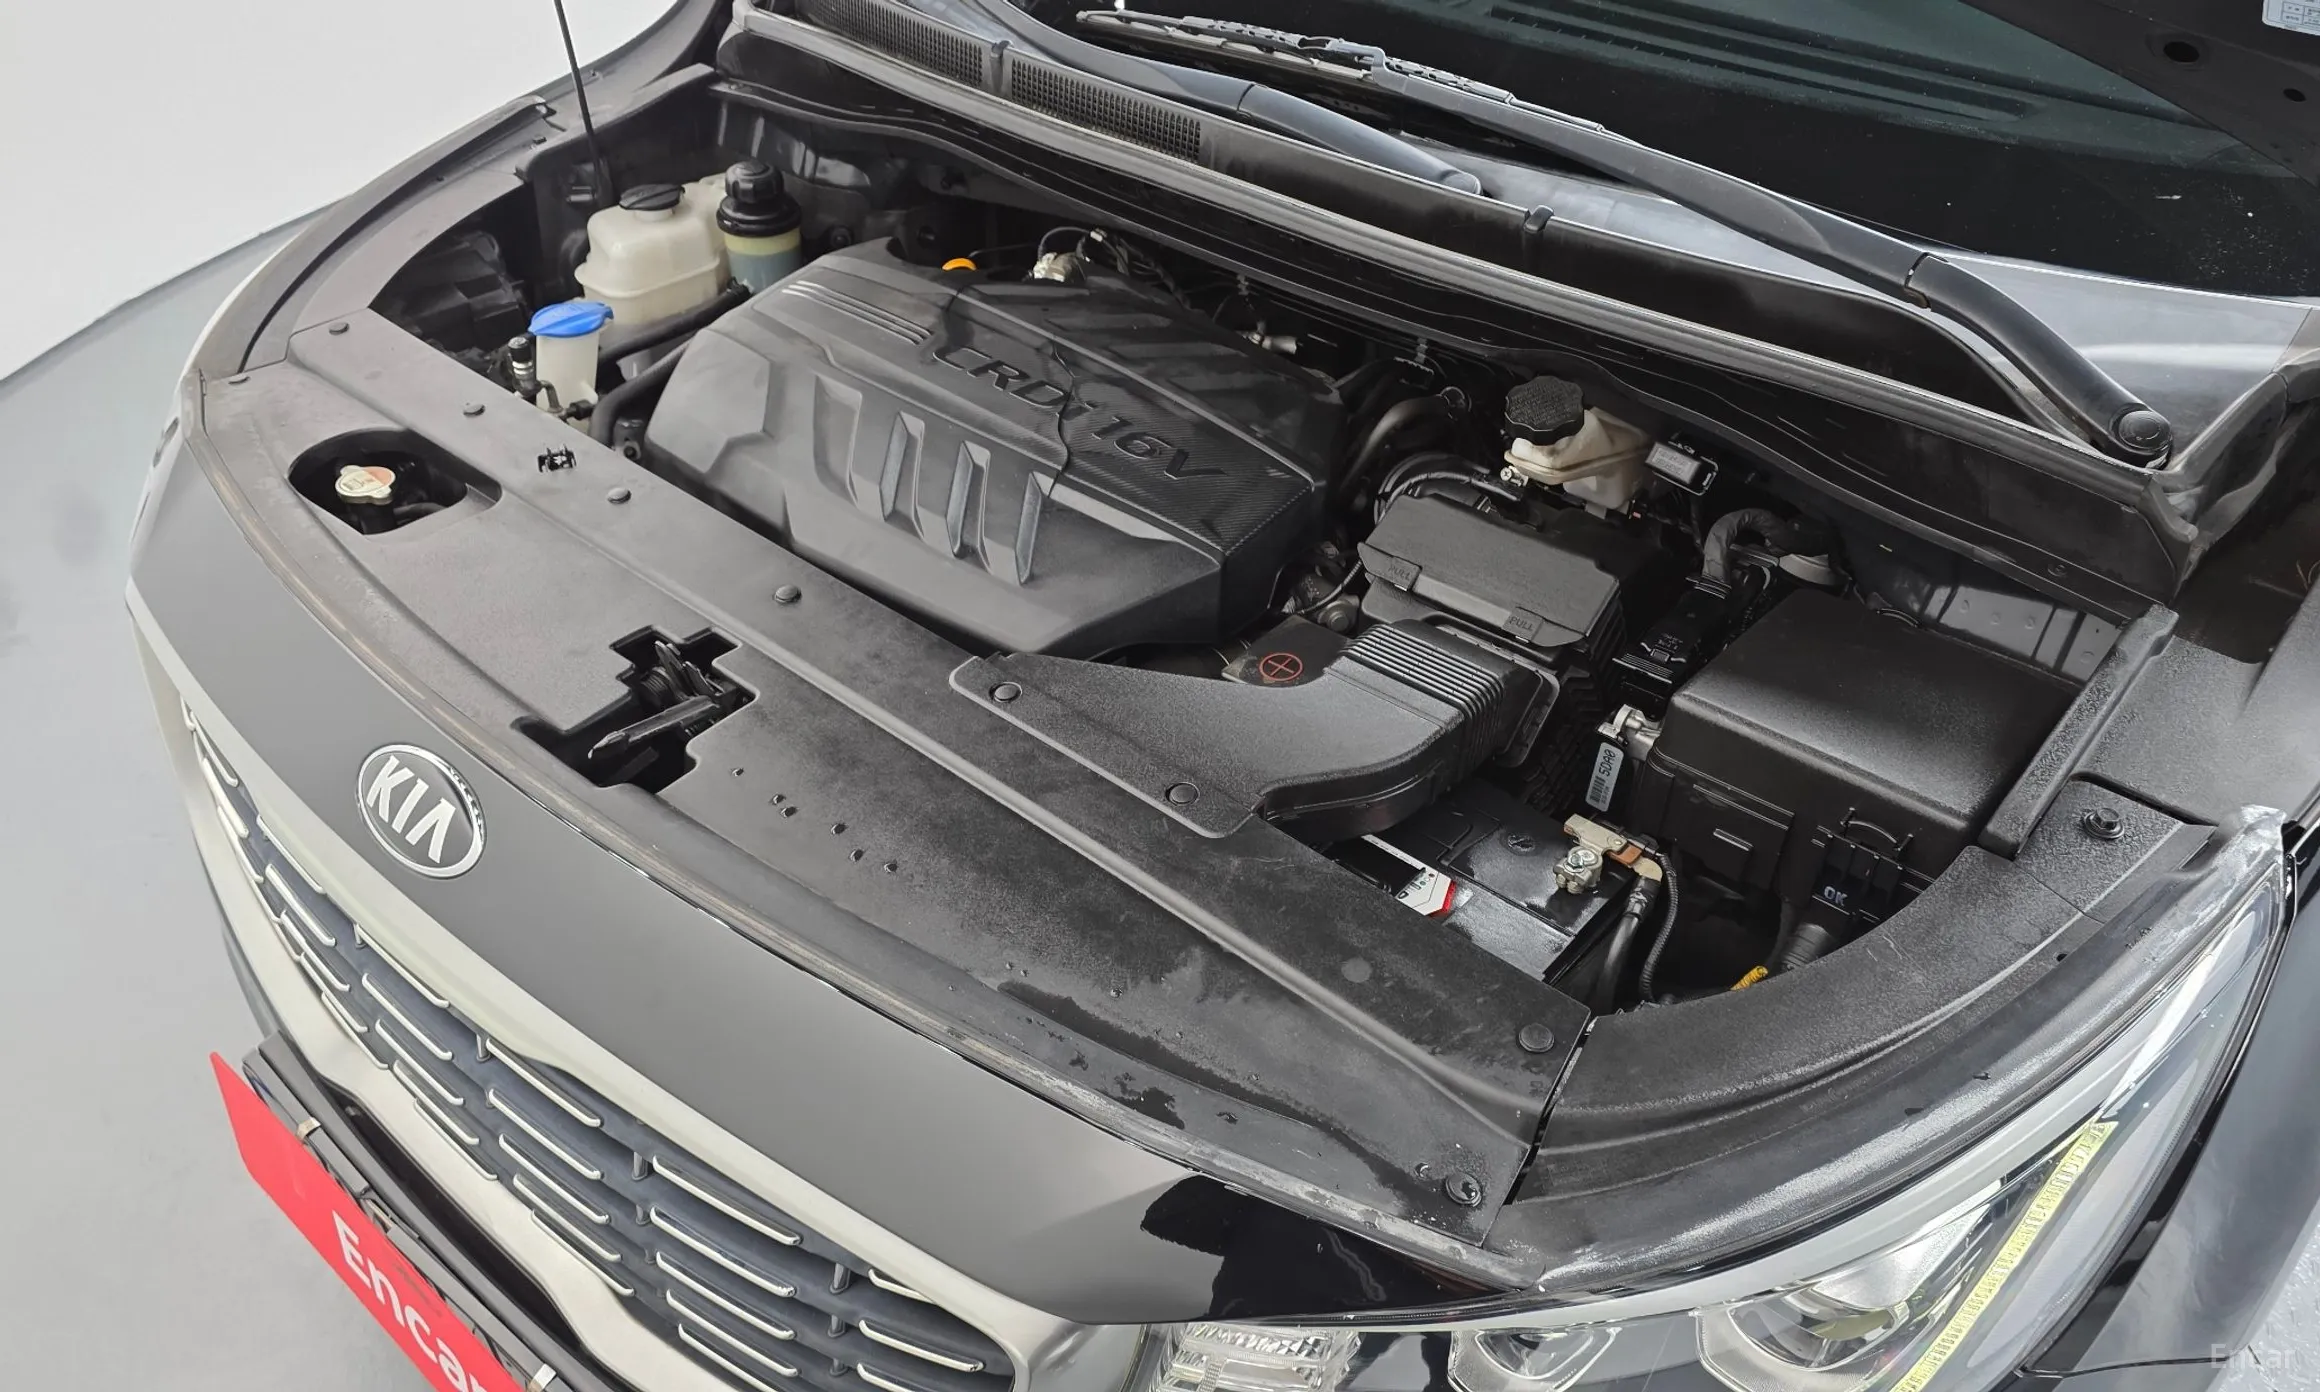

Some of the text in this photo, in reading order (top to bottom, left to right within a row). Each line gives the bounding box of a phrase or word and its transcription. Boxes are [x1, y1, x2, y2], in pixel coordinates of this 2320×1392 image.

[1091, 416, 1230, 480] 16V
[1509, 616, 1534, 631] PULL
[366, 754, 456, 864] KIA
[1824, 885, 1848, 907] OK
